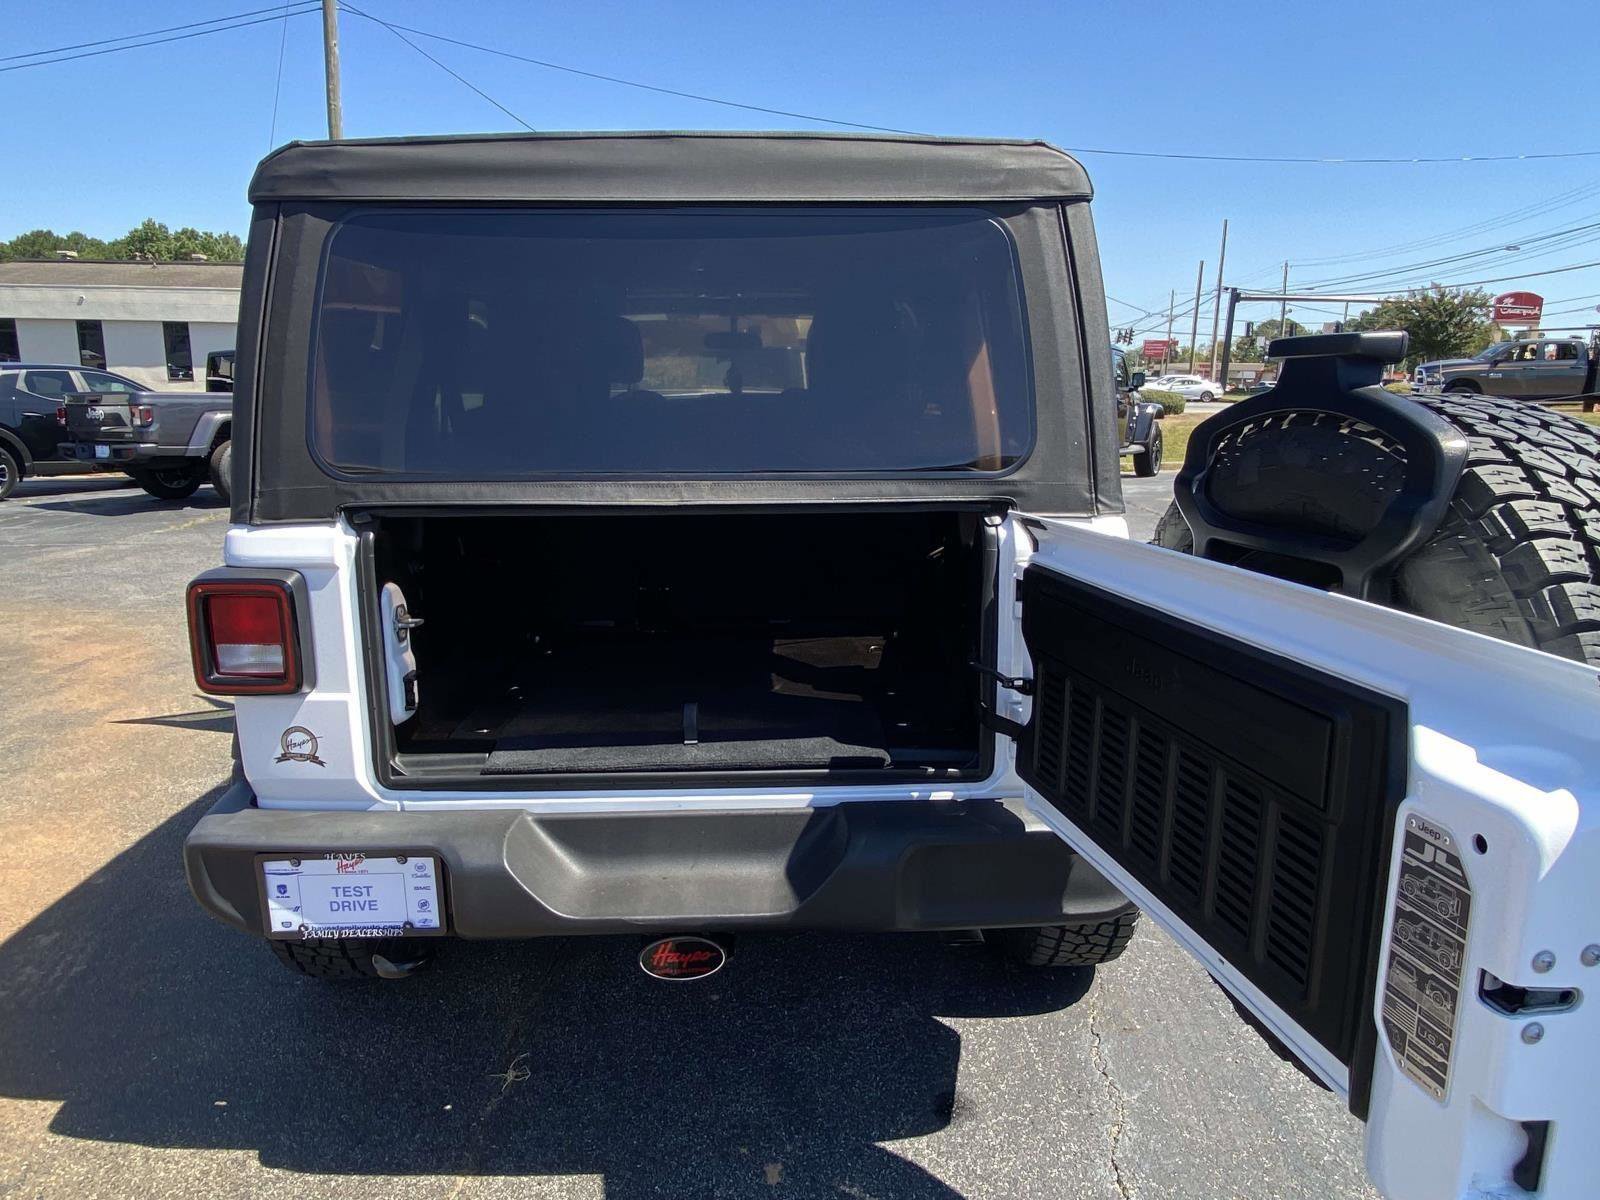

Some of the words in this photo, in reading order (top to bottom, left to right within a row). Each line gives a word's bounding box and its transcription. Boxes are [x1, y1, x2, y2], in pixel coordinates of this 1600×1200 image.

[86, 407, 105, 421] Jeep
[1418, 822, 1441, 840] Jeep
[1405, 843, 1463, 877] JL
[331, 886, 373, 898] TEST
[329, 900, 379, 912] DRIVE
[302, 929, 340, 940] FAMILY
[652, 941, 718, 967] Hayes
[1417, 1026, 1448, 1055] USA
